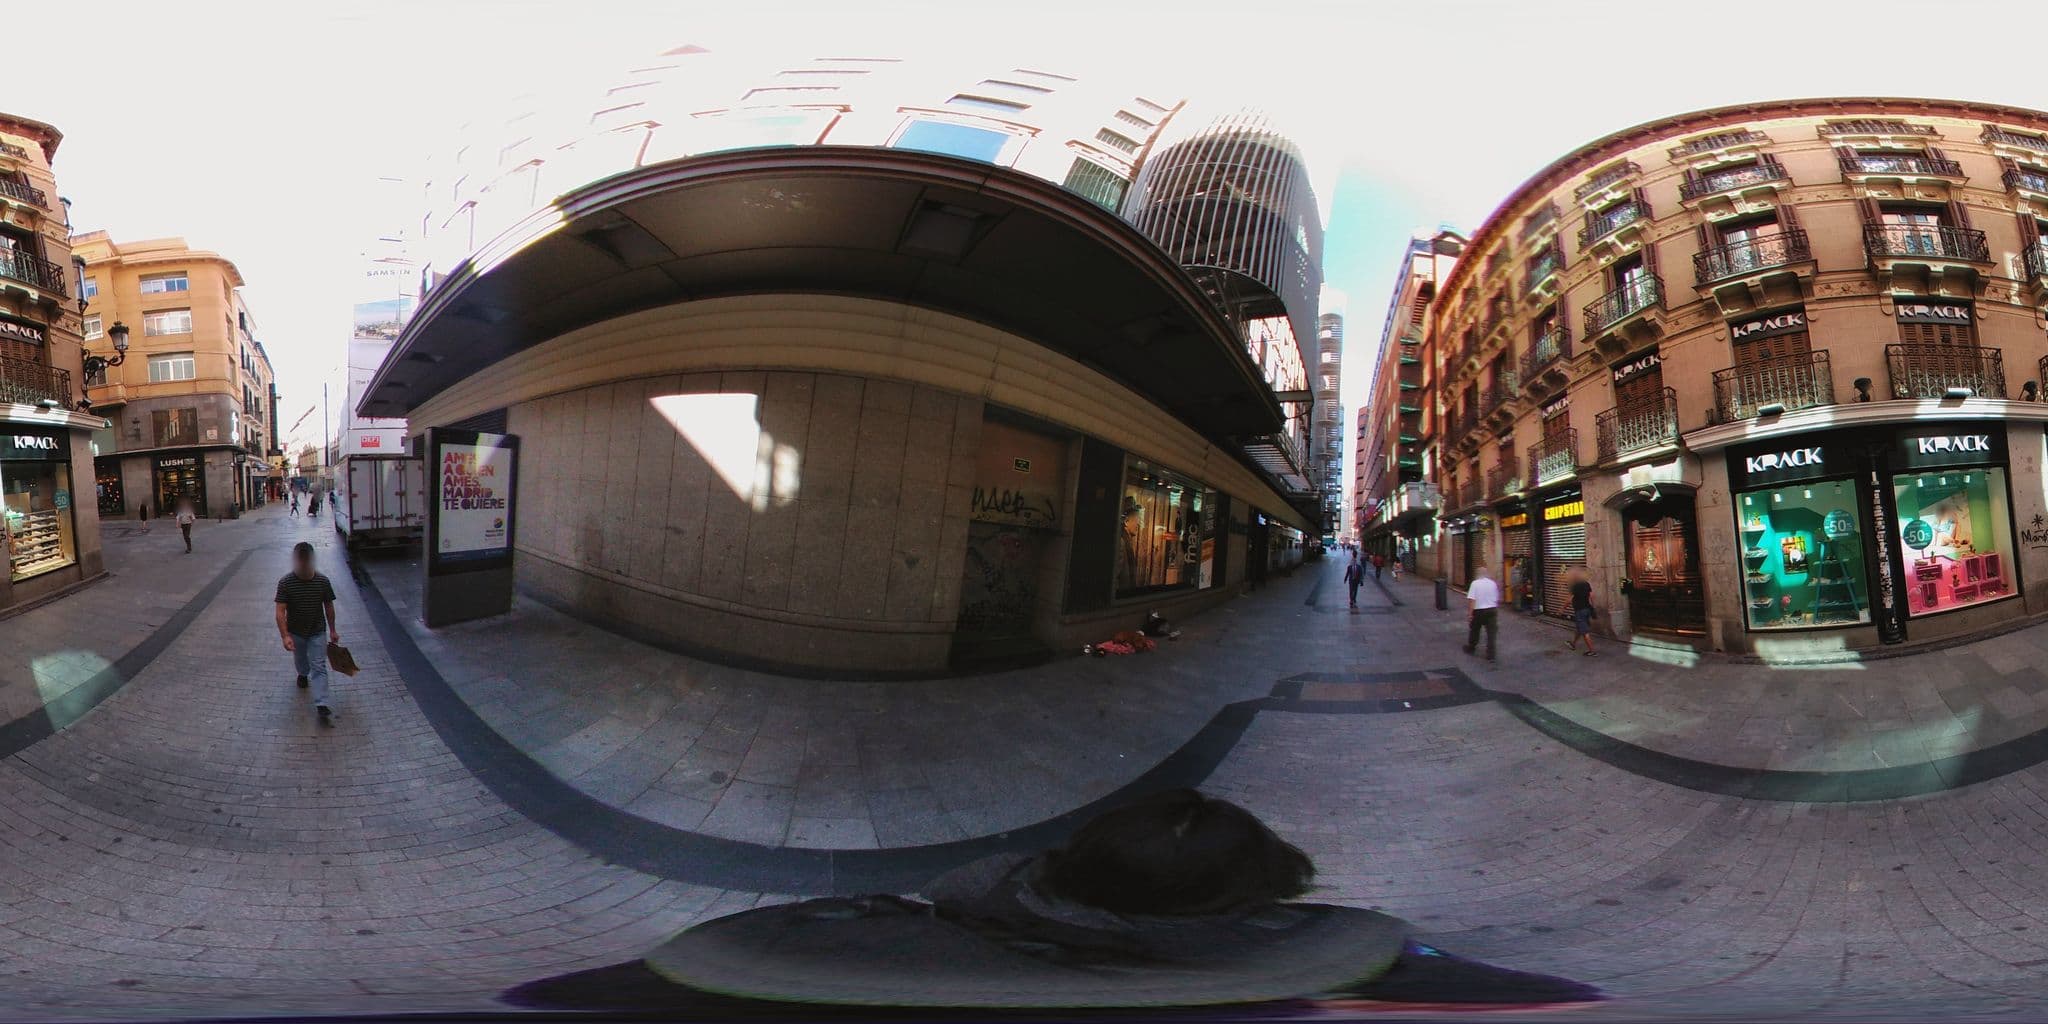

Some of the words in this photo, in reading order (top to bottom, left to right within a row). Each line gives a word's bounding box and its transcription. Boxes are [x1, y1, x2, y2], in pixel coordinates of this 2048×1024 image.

[1899, 304, 1969, 320] KRACK
[1733, 312, 1803, 339] KRACK
[1614, 354, 1661, 381] KRACK
[14, 435, 59, 449] KRACK
[1918, 435, 1990, 454] KRACK
[160, 459, 184, 467] LUSH
[1746, 447, 1823, 473] KRACK
[444, 464, 454, 476] A
[455, 464, 494, 476] QUEN
[443, 487, 493, 499] MADRID
[443, 498, 459, 510] TE
[460, 498, 505, 510] QUIERE
[1184, 524, 1199, 565] fnac
